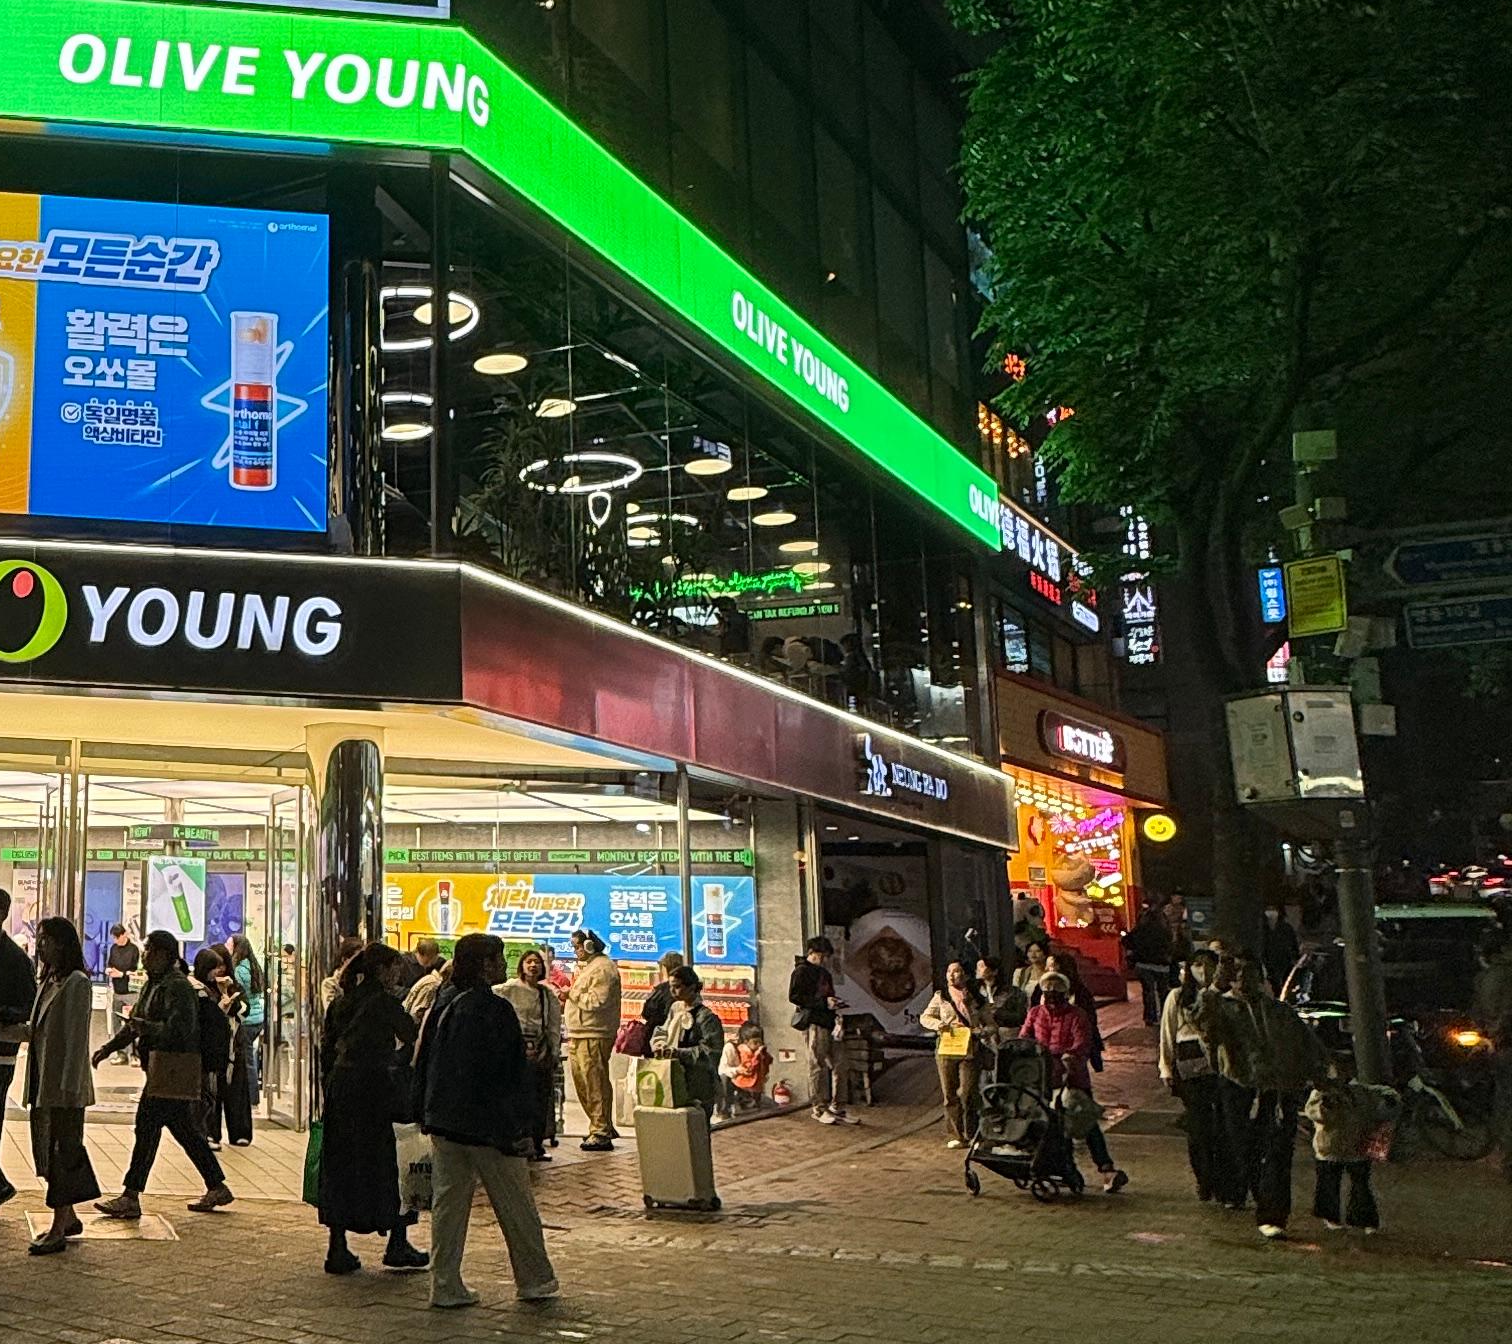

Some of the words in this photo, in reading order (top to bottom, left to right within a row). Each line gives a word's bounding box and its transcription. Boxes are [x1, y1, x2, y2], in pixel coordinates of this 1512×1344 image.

[58, 33, 261, 95] OLIVE
[283, 49, 489, 127] YOUNG
[66, 308, 189, 357] 활력은
[732, 290, 788, 366] OLIVE
[790, 335, 849, 414] YOUNG
[63, 355, 157, 391] 오쏘몰
[85, 405, 157, 427] 독일명품
[84, 426, 161, 445] 액상비타민
[81, 585, 343, 656] YOUNG
[890, 761, 923, 793] NEUNG
[934, 776, 949, 800] DO
[411, 851, 431, 861] BEST
[431, 851, 454, 861] ITEMS
[455, 851, 476, 861] WITH
[476, 851, 492, 861] THE
[492, 851, 512, 861] BEST
[596, 851, 636, 862] MONTHLY
[637, 851, 659, 862] BEST
[659, 851, 681, 862] ITEM
[690, 851, 713, 862] WITH
[715, 851, 733, 862] THE
[609, 890, 668, 912] 활력은
[609, 912, 654, 928] 오쏘몰
